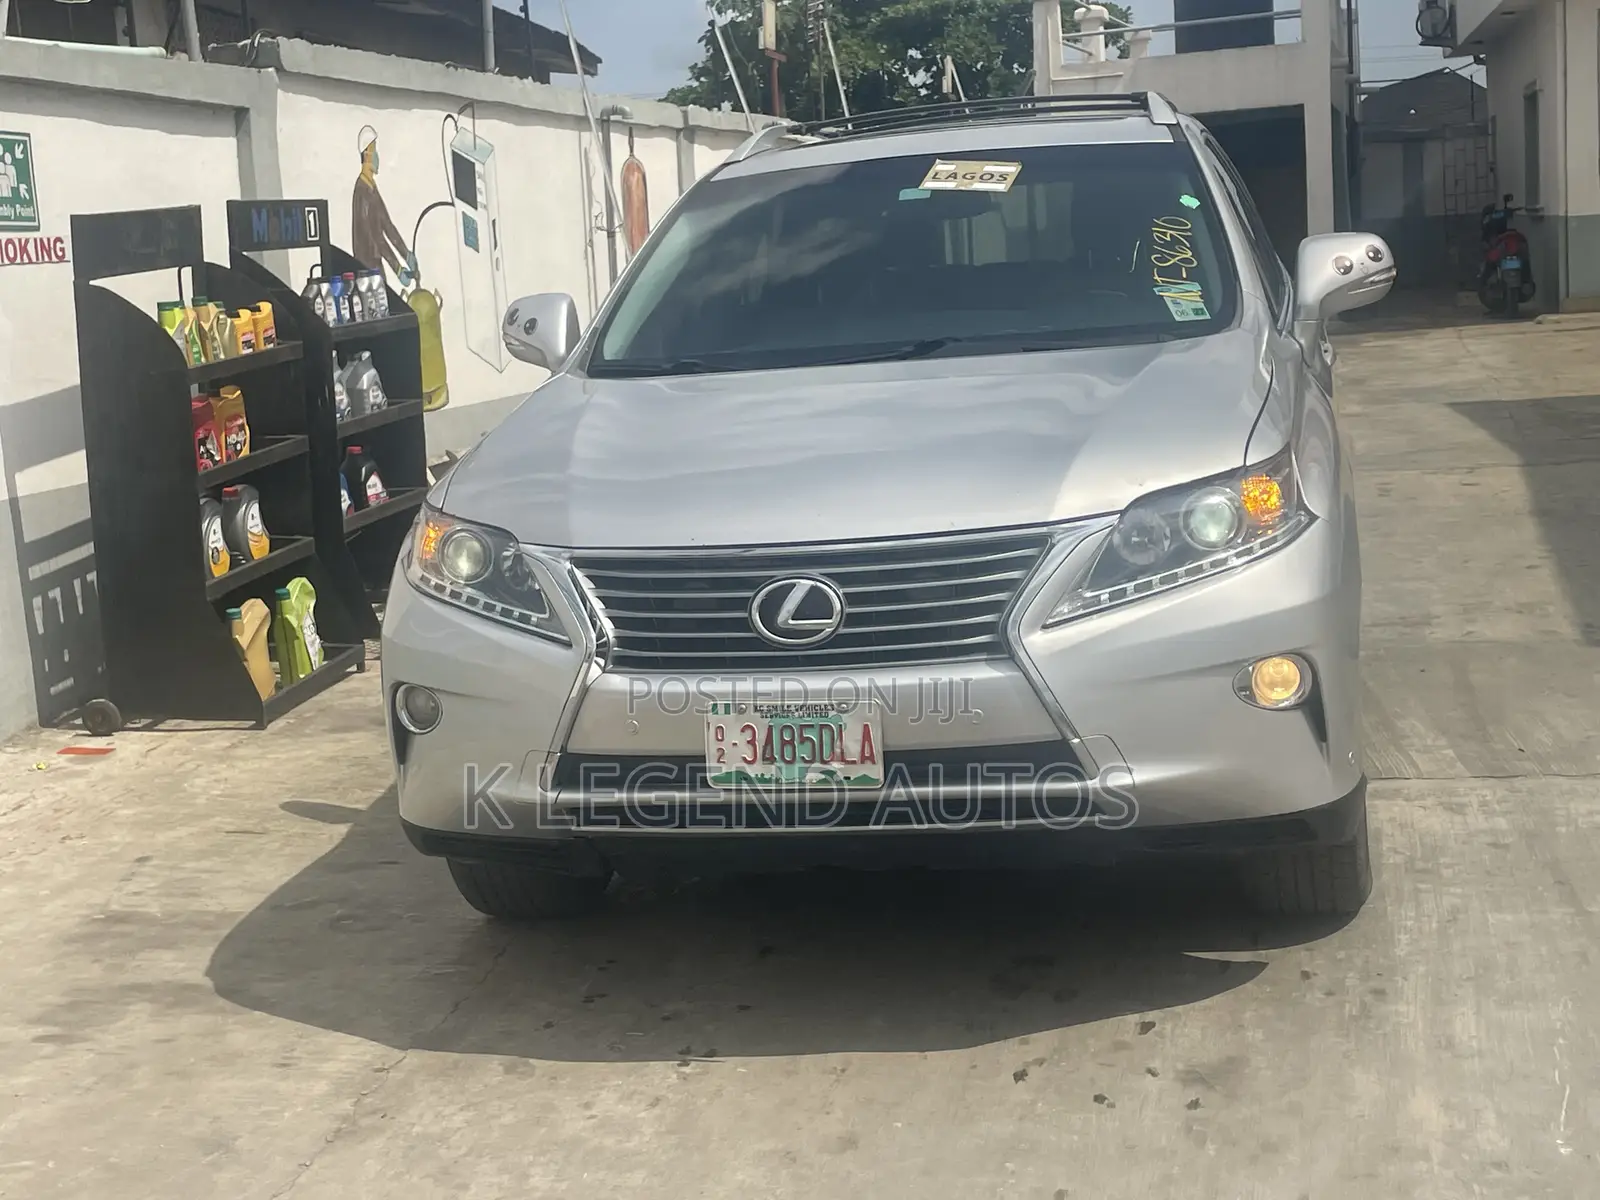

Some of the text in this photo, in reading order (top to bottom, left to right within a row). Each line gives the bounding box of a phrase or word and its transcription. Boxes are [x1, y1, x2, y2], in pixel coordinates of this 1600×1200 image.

[931, 171, 1010, 181] LAGOS
[16, 203, 35, 217] Point
[251, 206, 302, 243] Mobil
[0, 236, 66, 263] OKING
[798, 711, 830, 719] LIMITED
